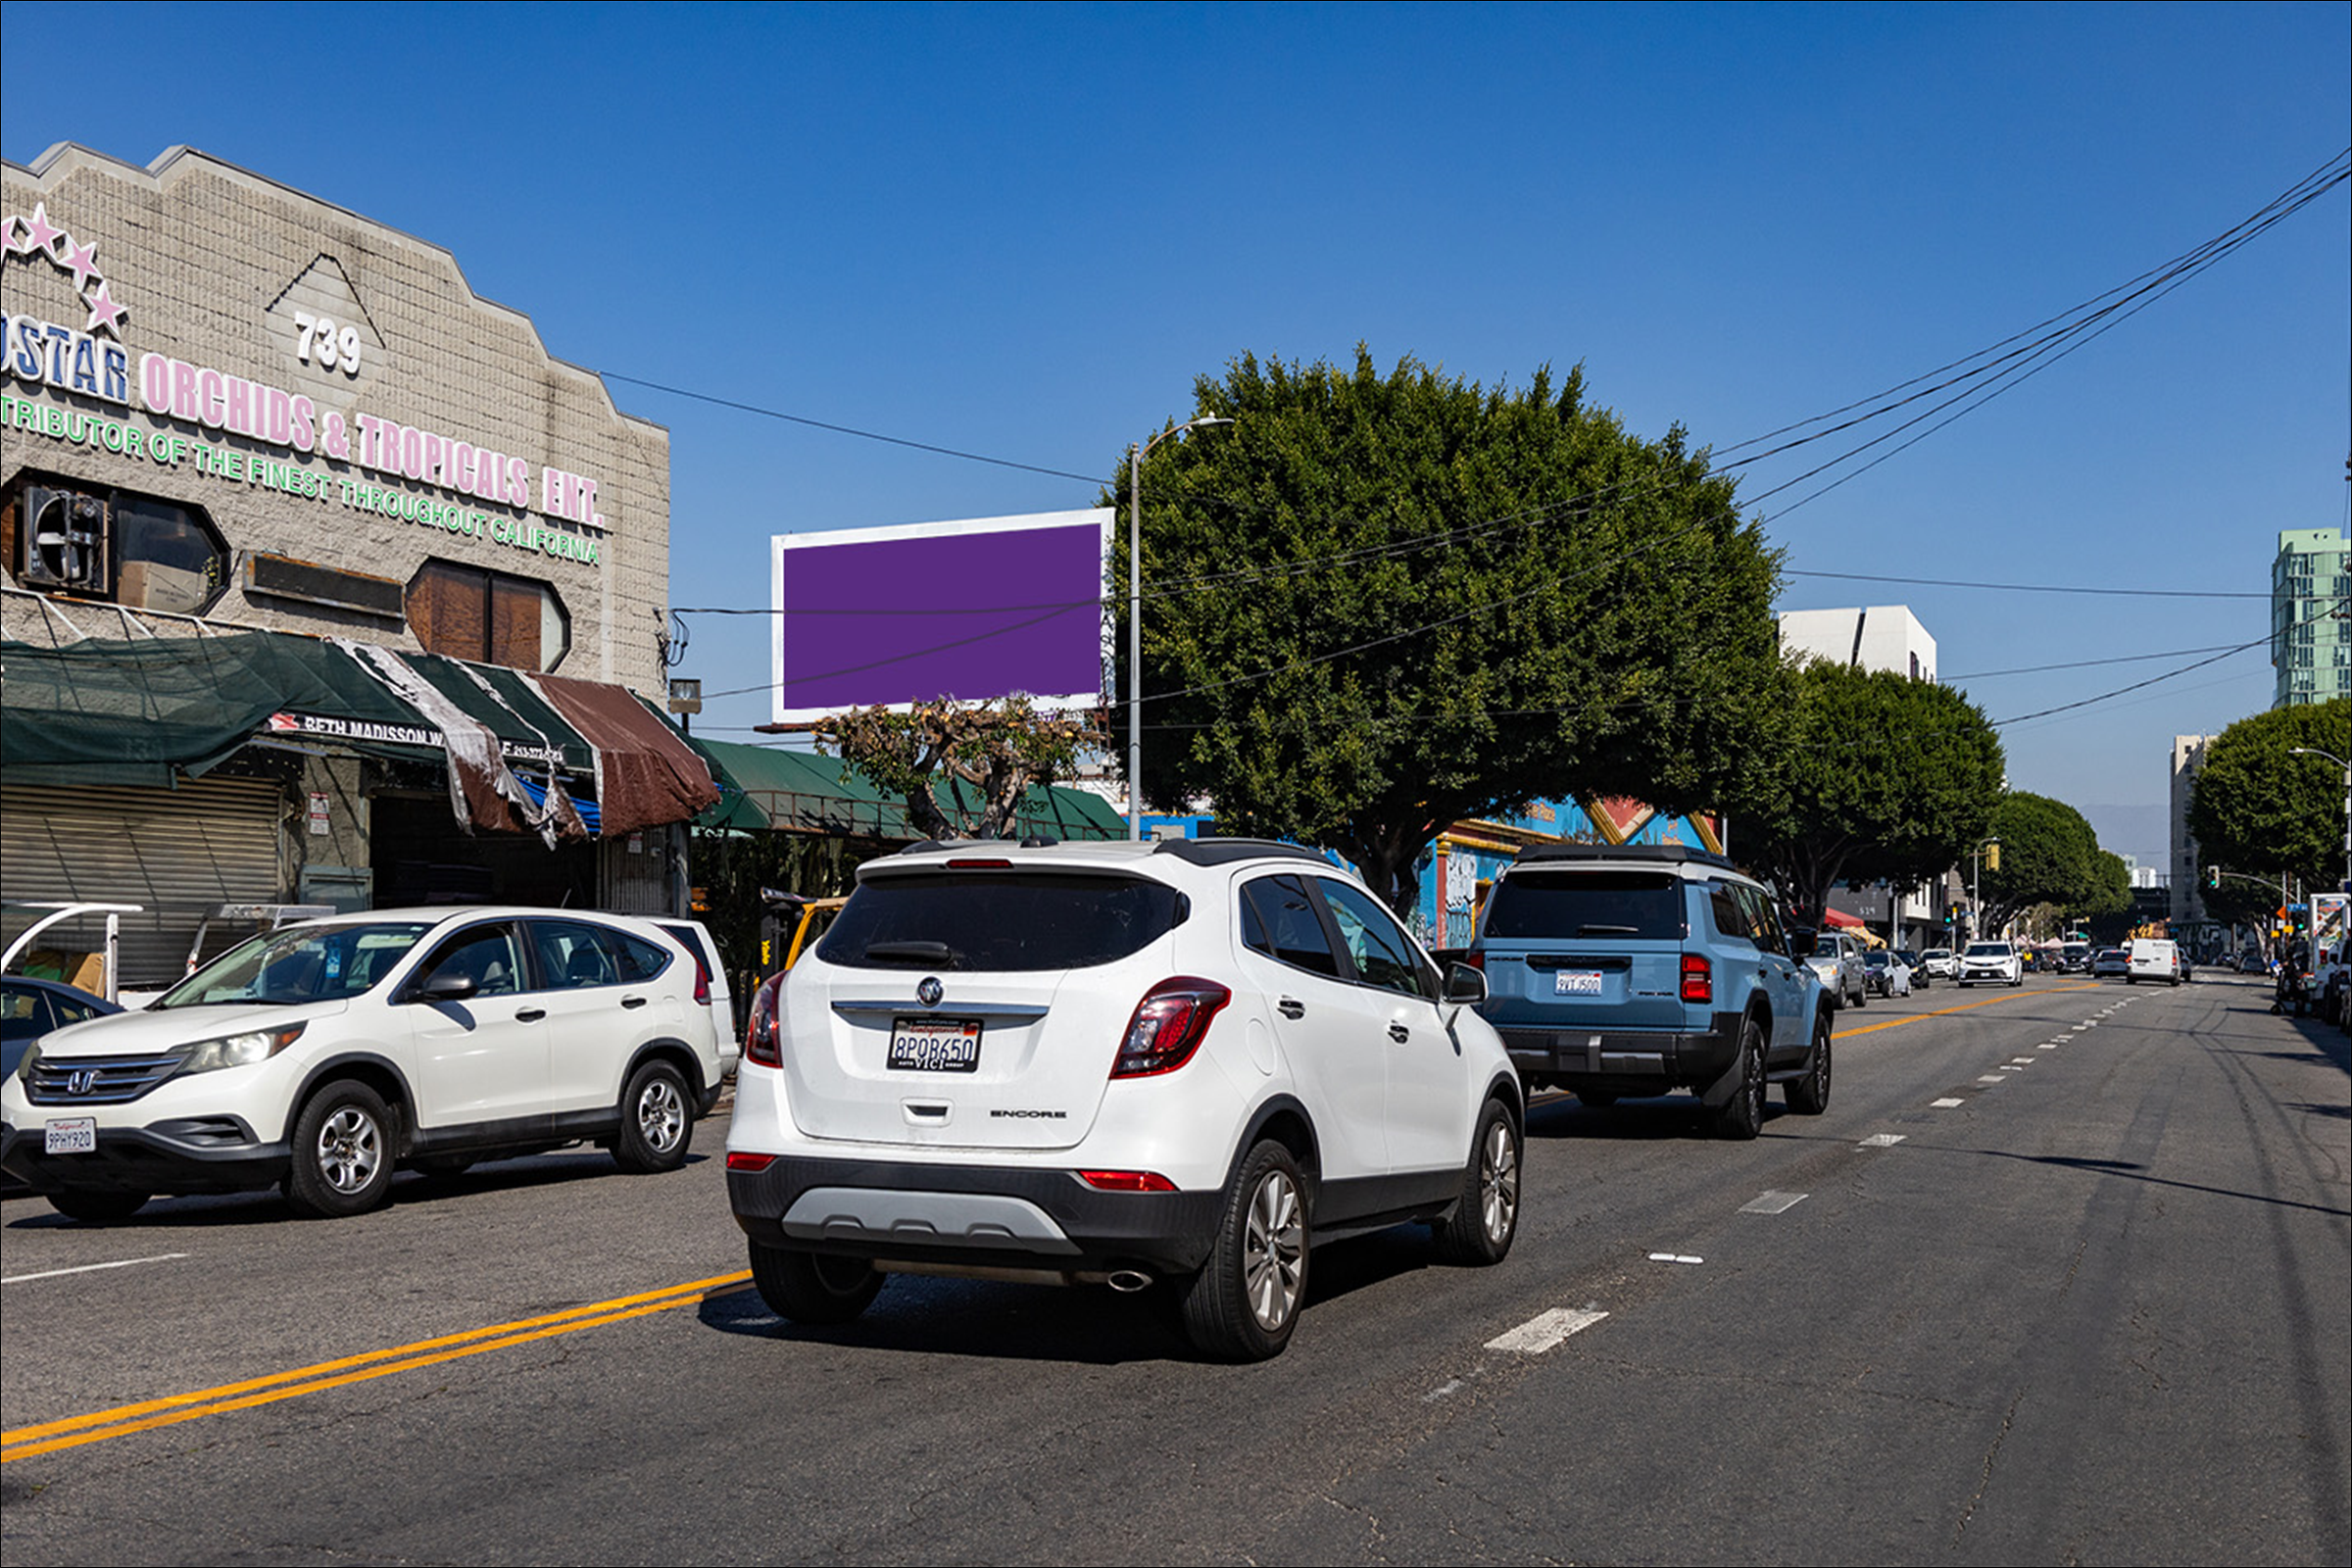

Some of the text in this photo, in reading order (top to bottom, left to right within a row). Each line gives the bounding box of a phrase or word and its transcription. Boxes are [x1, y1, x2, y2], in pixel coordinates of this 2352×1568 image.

[295, 311, 361, 373] 739
[140, 352, 315, 453] ORCHIDS
[321, 411, 350, 462] &
[356, 413, 529, 508] TROPICALS
[542, 466, 605, 528] ENT.
[148, 434, 186, 466] OF
[194, 443, 243, 480] THE
[248, 458, 331, 499] FINEST
[340, 479, 487, 537] THROUGHOUT
[491, 518, 600, 565] CALIFORNIA
[304, 716, 345, 735] BETH
[350, 722, 426, 744] MADISSON
[915, 1058, 945, 1070] VICI
[990, 1110, 1067, 1119] ENCORE
